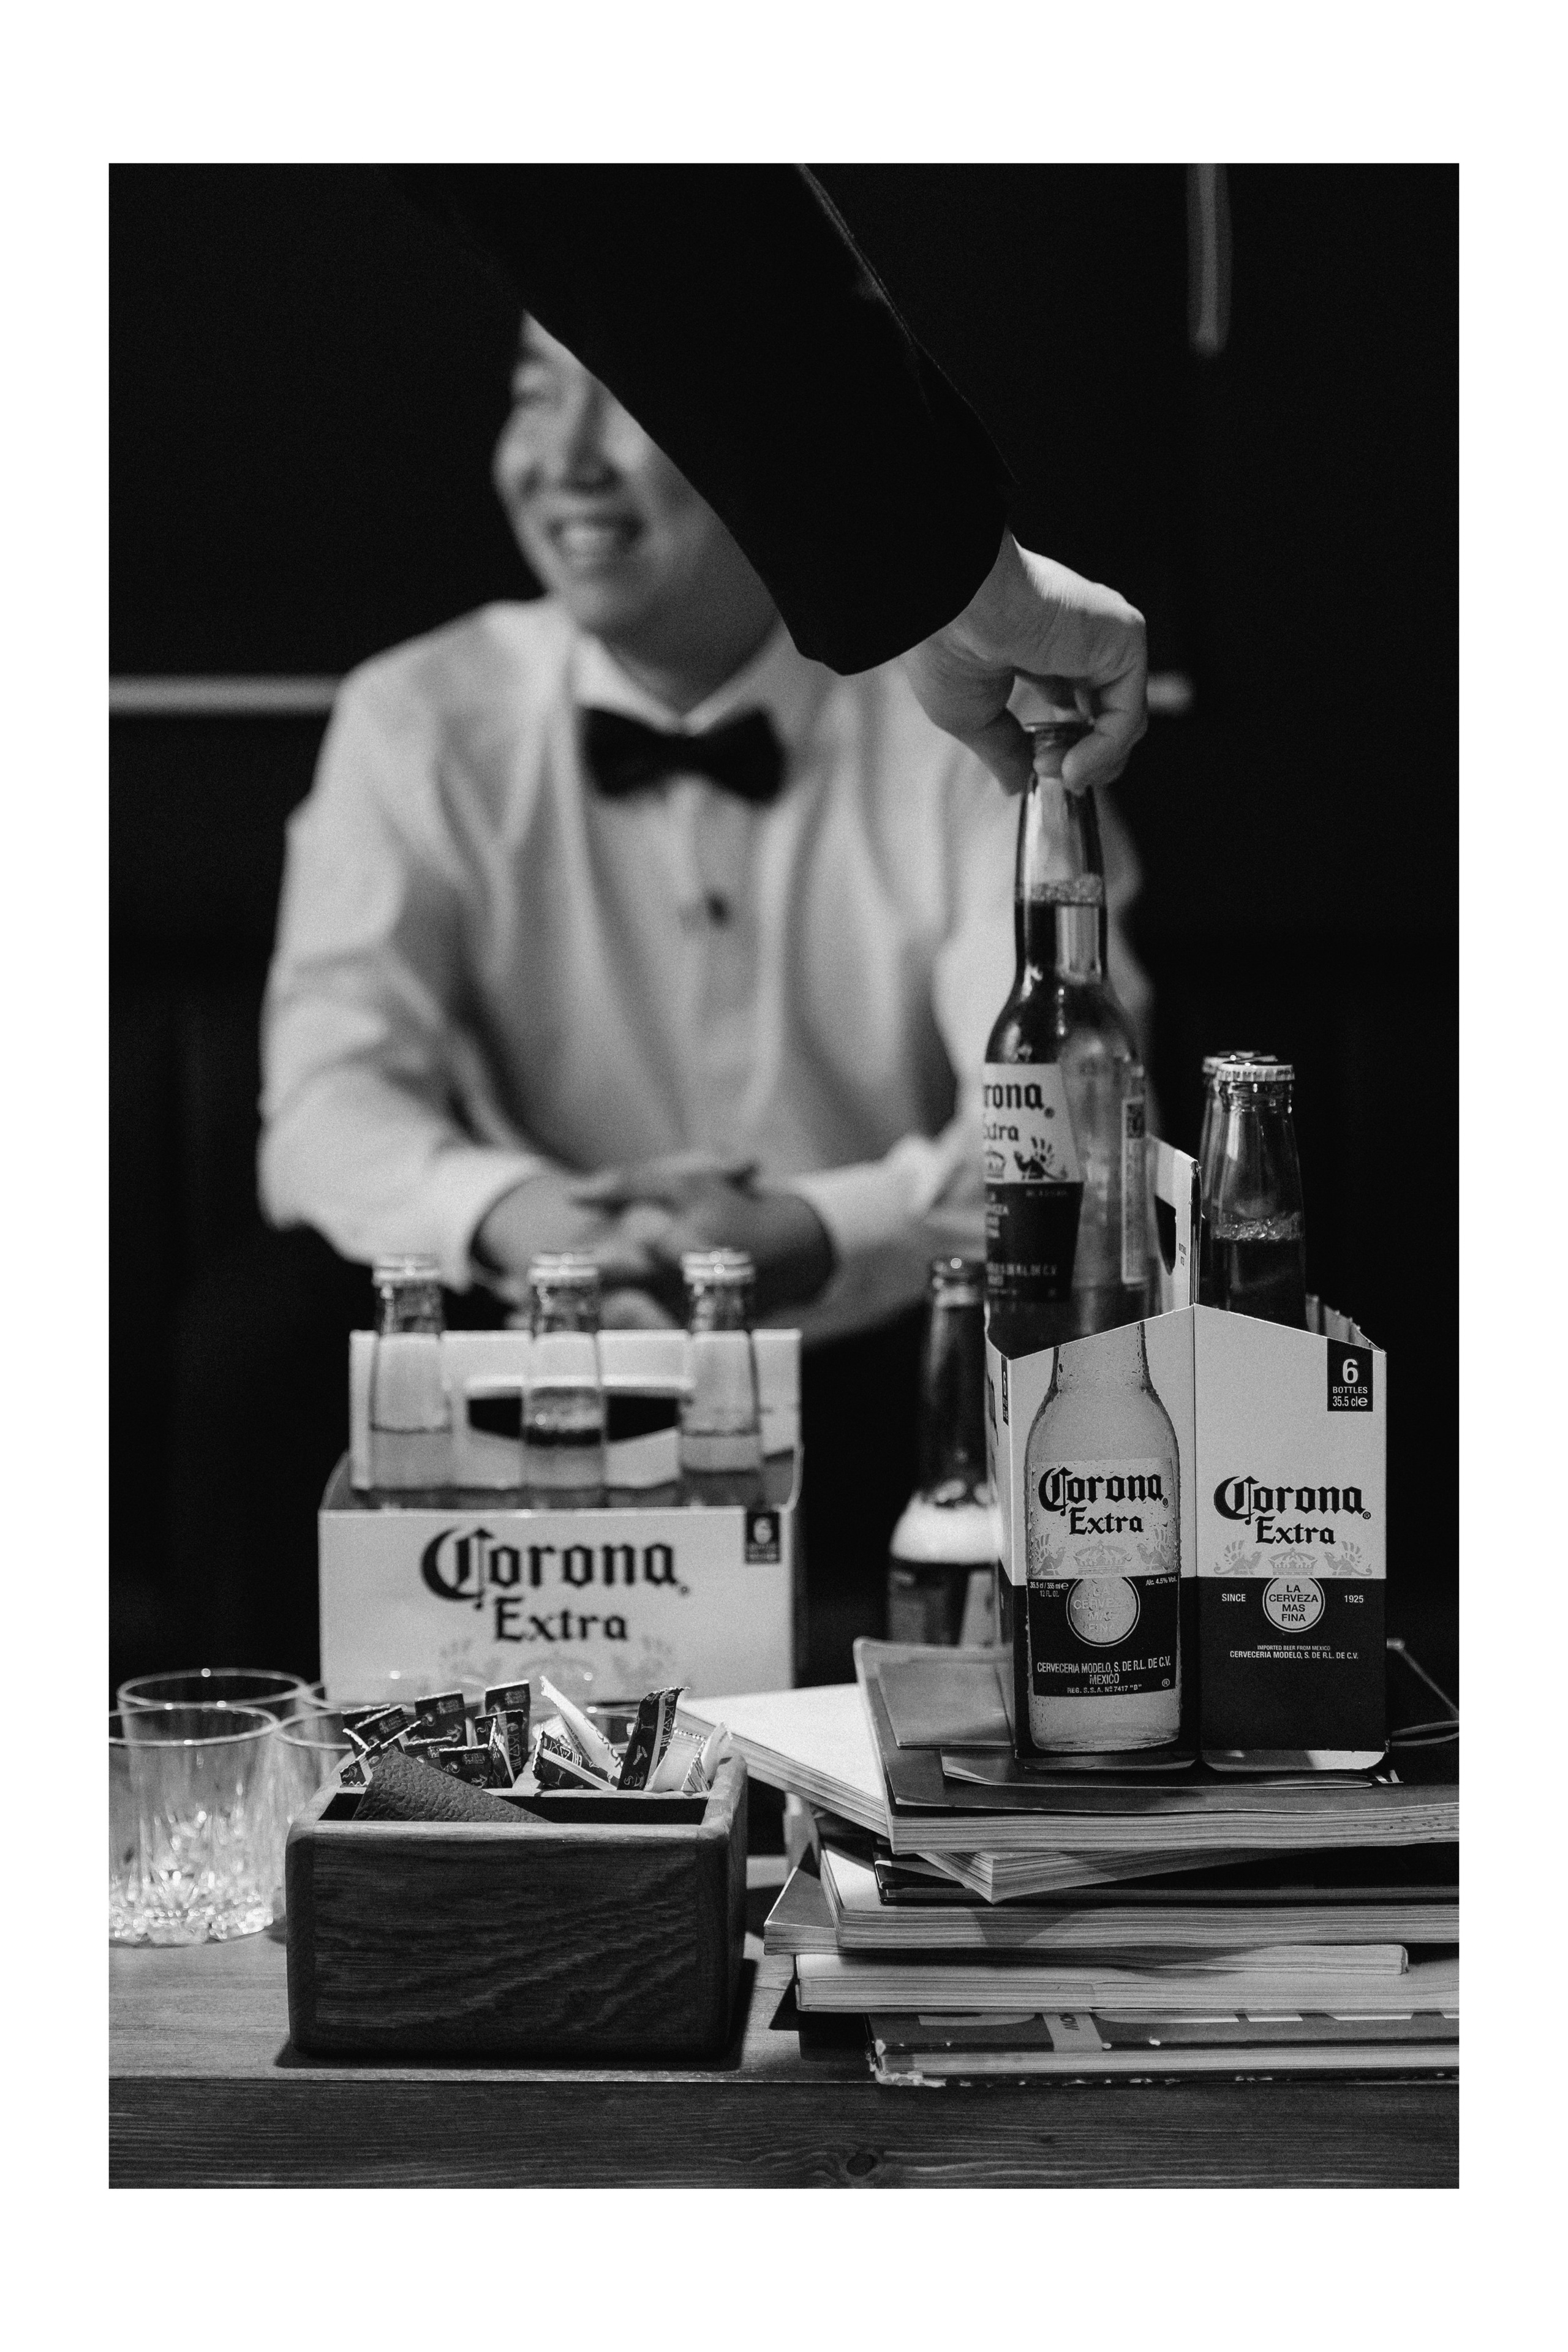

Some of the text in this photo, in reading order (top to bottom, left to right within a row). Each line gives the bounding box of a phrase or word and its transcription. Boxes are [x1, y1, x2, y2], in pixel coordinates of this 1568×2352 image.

[1343, 1359, 1359, 1384] 6
[1332, 1396, 1349, 1407] 35.5
[1038, 1466, 1164, 1517] Corona
[1213, 1475, 1366, 1526] Corona
[1068, 1506, 1144, 1536] Extra
[1254, 1515, 1336, 1545] Extra
[421, 1526, 680, 1610] Corona
[1286, 1585, 1301, 1593] LA
[1221, 1593, 1246, 1602] SINCE
[1268, 1594, 1319, 1602] CERVEZA
[1344, 1595, 1364, 1604] 1925
[1282, 1604, 1306, 1612] MAS
[494, 1596, 628, 1643] Extra
[1281, 1613, 1306, 1622] FINA
[1273, 1651, 1303, 1660] MODELO,
[1037, 1656, 1171, 1675] CERVECERIA MODELO, S. DE R.L. DE C.V.
[1089, 1673, 1120, 1685] MEXICO
